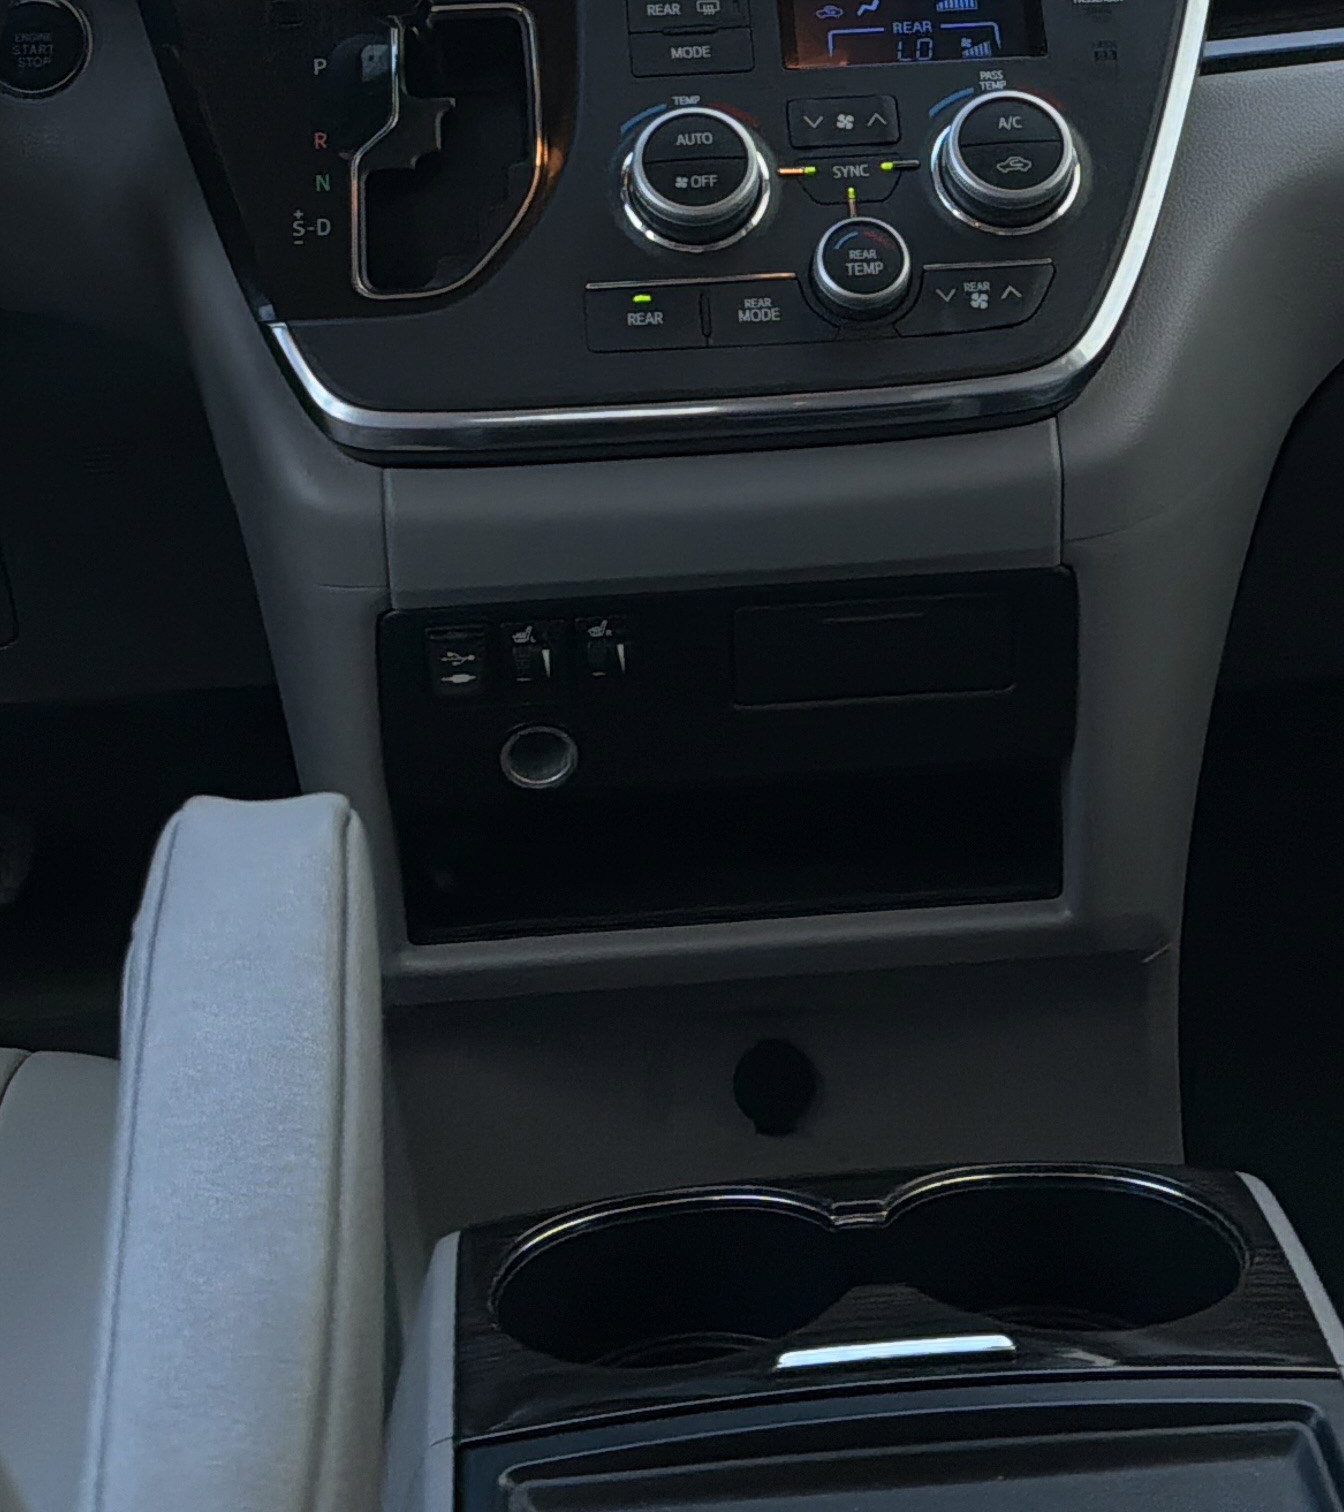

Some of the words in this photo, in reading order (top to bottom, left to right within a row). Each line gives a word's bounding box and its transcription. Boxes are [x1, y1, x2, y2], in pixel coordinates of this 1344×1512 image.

[646, 2, 681, 16] REAR
[892, 21, 933, 34] REAR
[670, 46, 711, 60] MODE
[897, 38, 933, 61] LO
[313, 58, 327, 75] P
[979, 70, 1004, 80] PASS
[979, 80, 1006, 91] TEMP
[671, 95, 701, 106] TEMP
[998, 116, 1023, 130] A/C
[313, 131, 328, 150] R
[676, 132, 713, 146] AUTO
[832, 164, 870, 179] SYNC
[315, 174, 331, 192] N
[690, 174, 718, 188] OFF
[848, 249, 877, 260] REAR
[845, 262, 884, 276] TEMP
[963, 281, 990, 292] REAR
[744, 297, 772, 308] REAR
[627, 311, 663, 326] REAR
[738, 308, 781, 322] MODE
